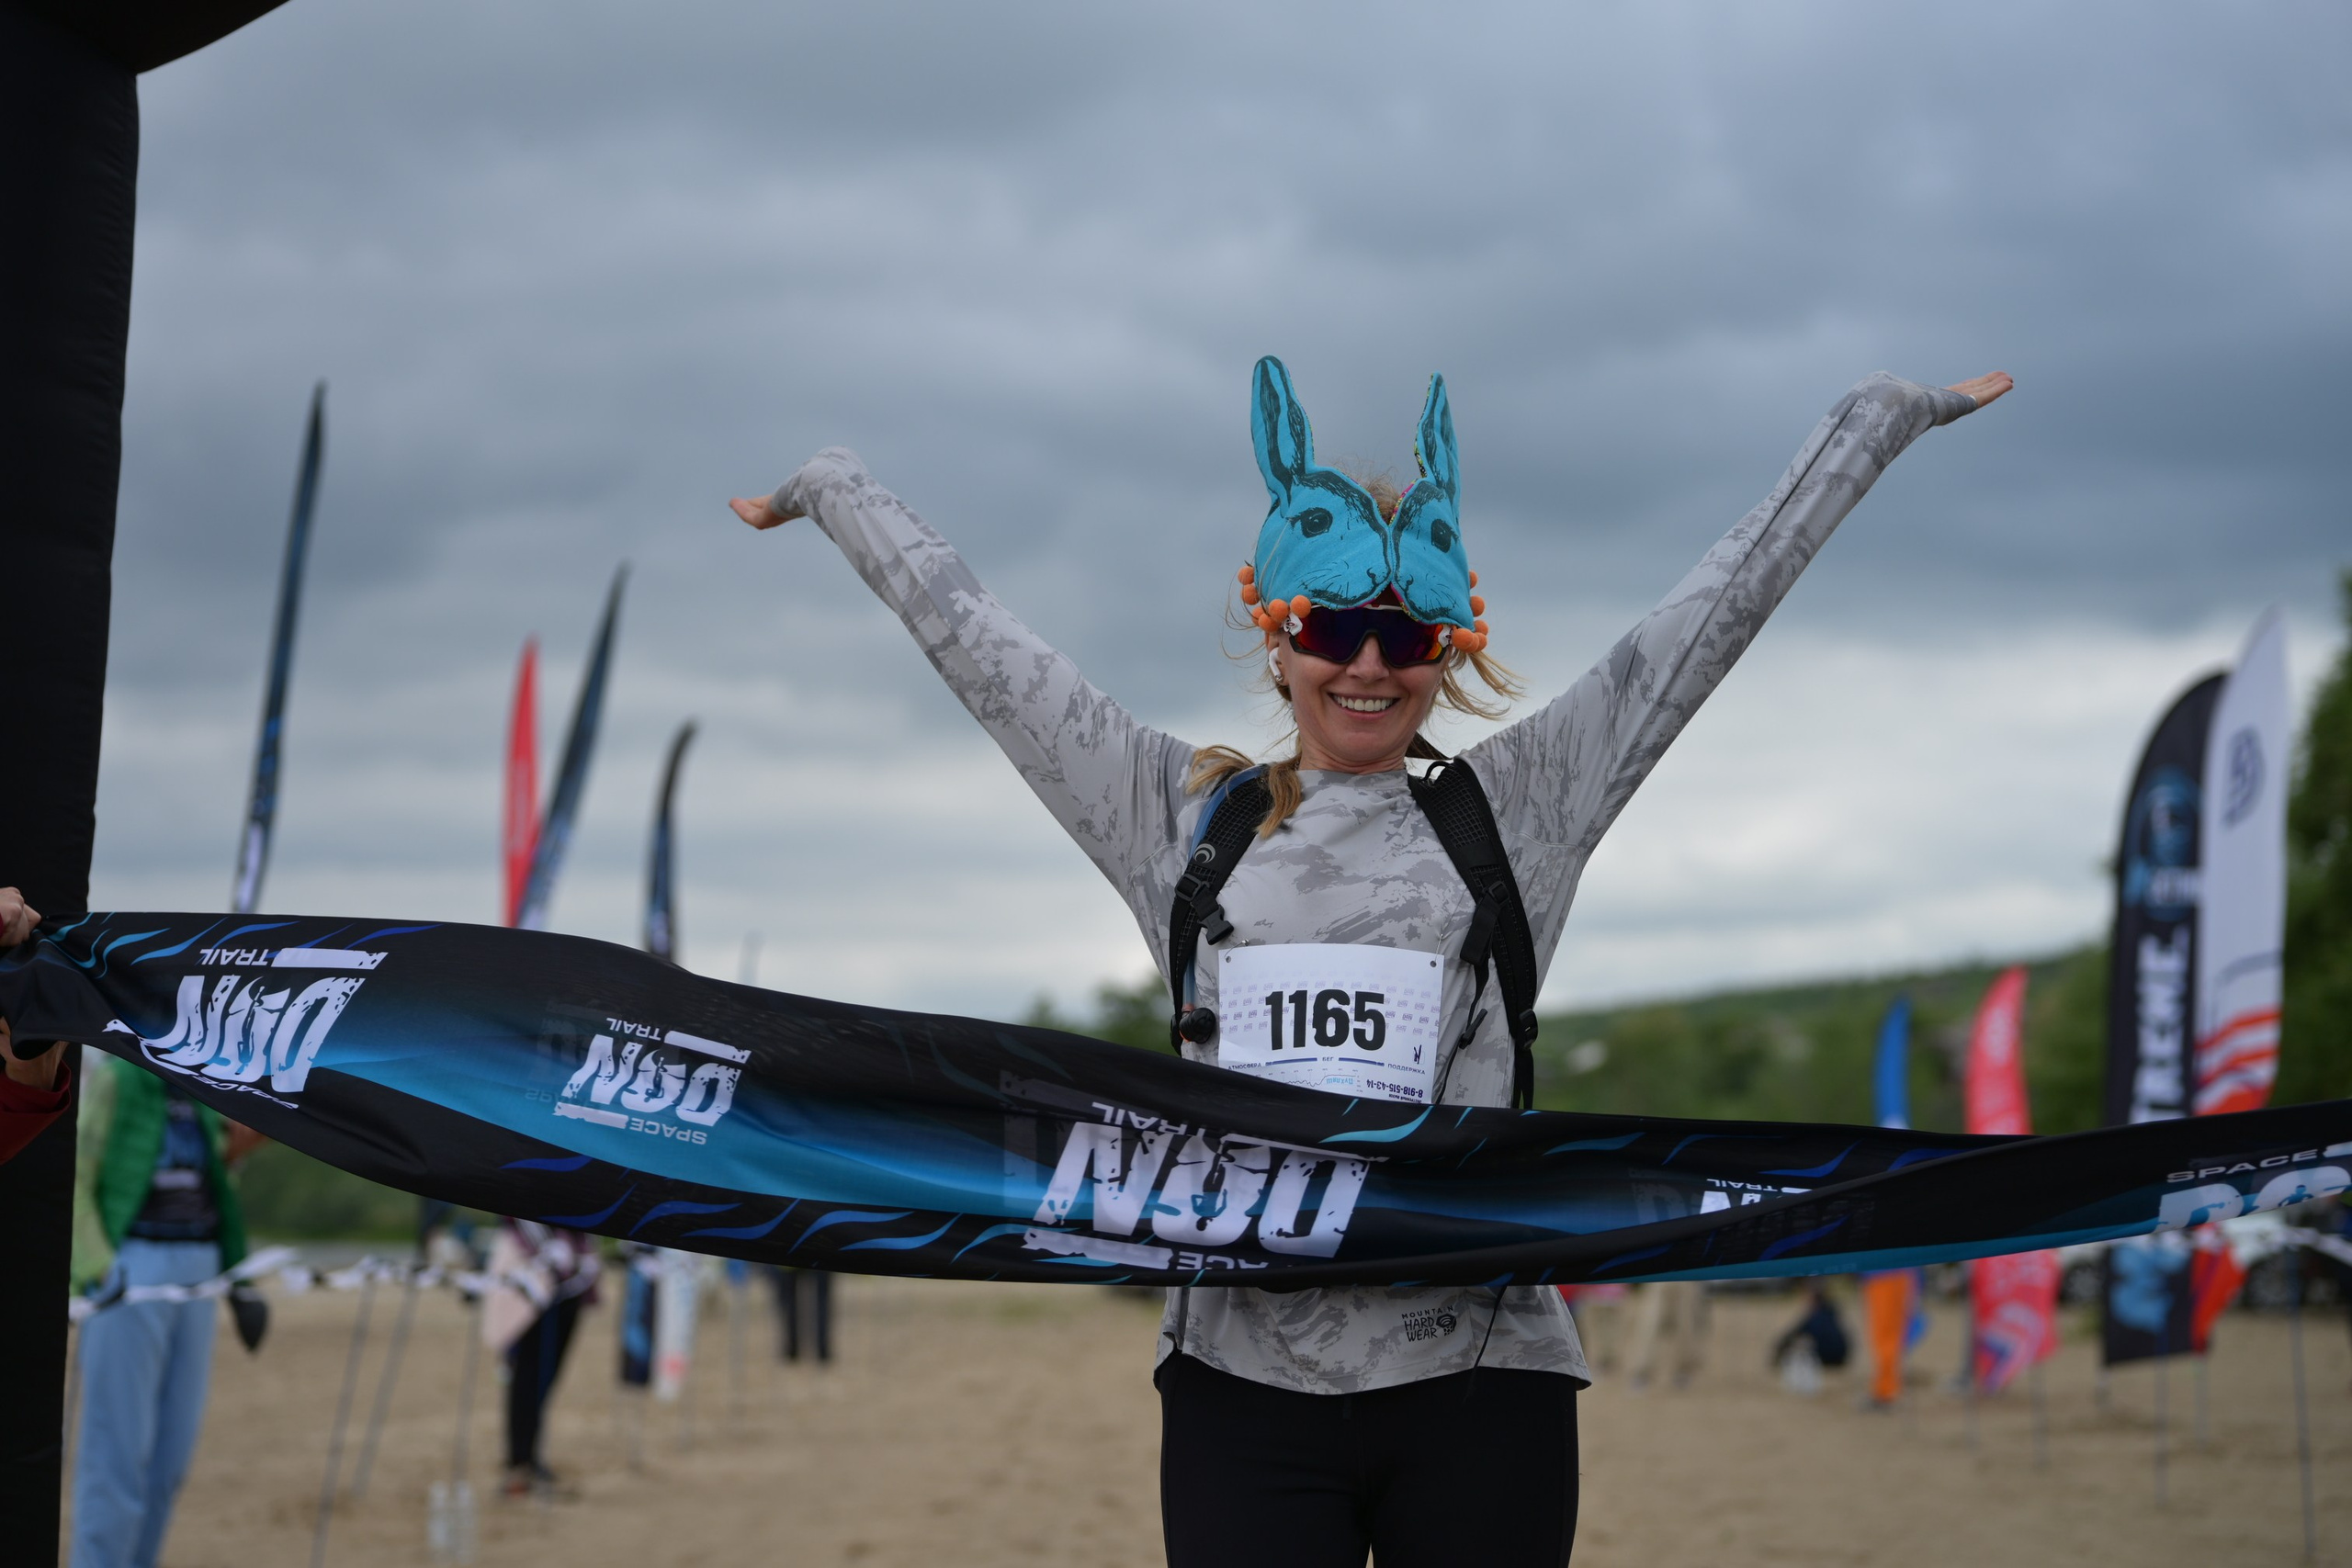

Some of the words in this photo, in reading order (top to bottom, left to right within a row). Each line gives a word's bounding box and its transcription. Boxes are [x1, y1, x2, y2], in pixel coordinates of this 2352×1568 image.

[199, 948, 269, 966] TRAIL
[1265, 988, 1386, 1051] 1165
[606, 1017, 662, 1041] TRAIL
[1387, 1063, 1426, 1075] ПОДДЕРЖКА
[1366, 1078, 1423, 1098] 8-918-515-43-14
[629, 1117, 707, 1145] SPACE
[2166, 1149, 2318, 1183] SPACE
[1706, 1179, 1778, 1192] TRAIL
[1401, 1305, 1453, 1319] MOUNTAIN
[1404, 1316, 1435, 1331] HARD
[1407, 1327, 1438, 1342] WEAR
